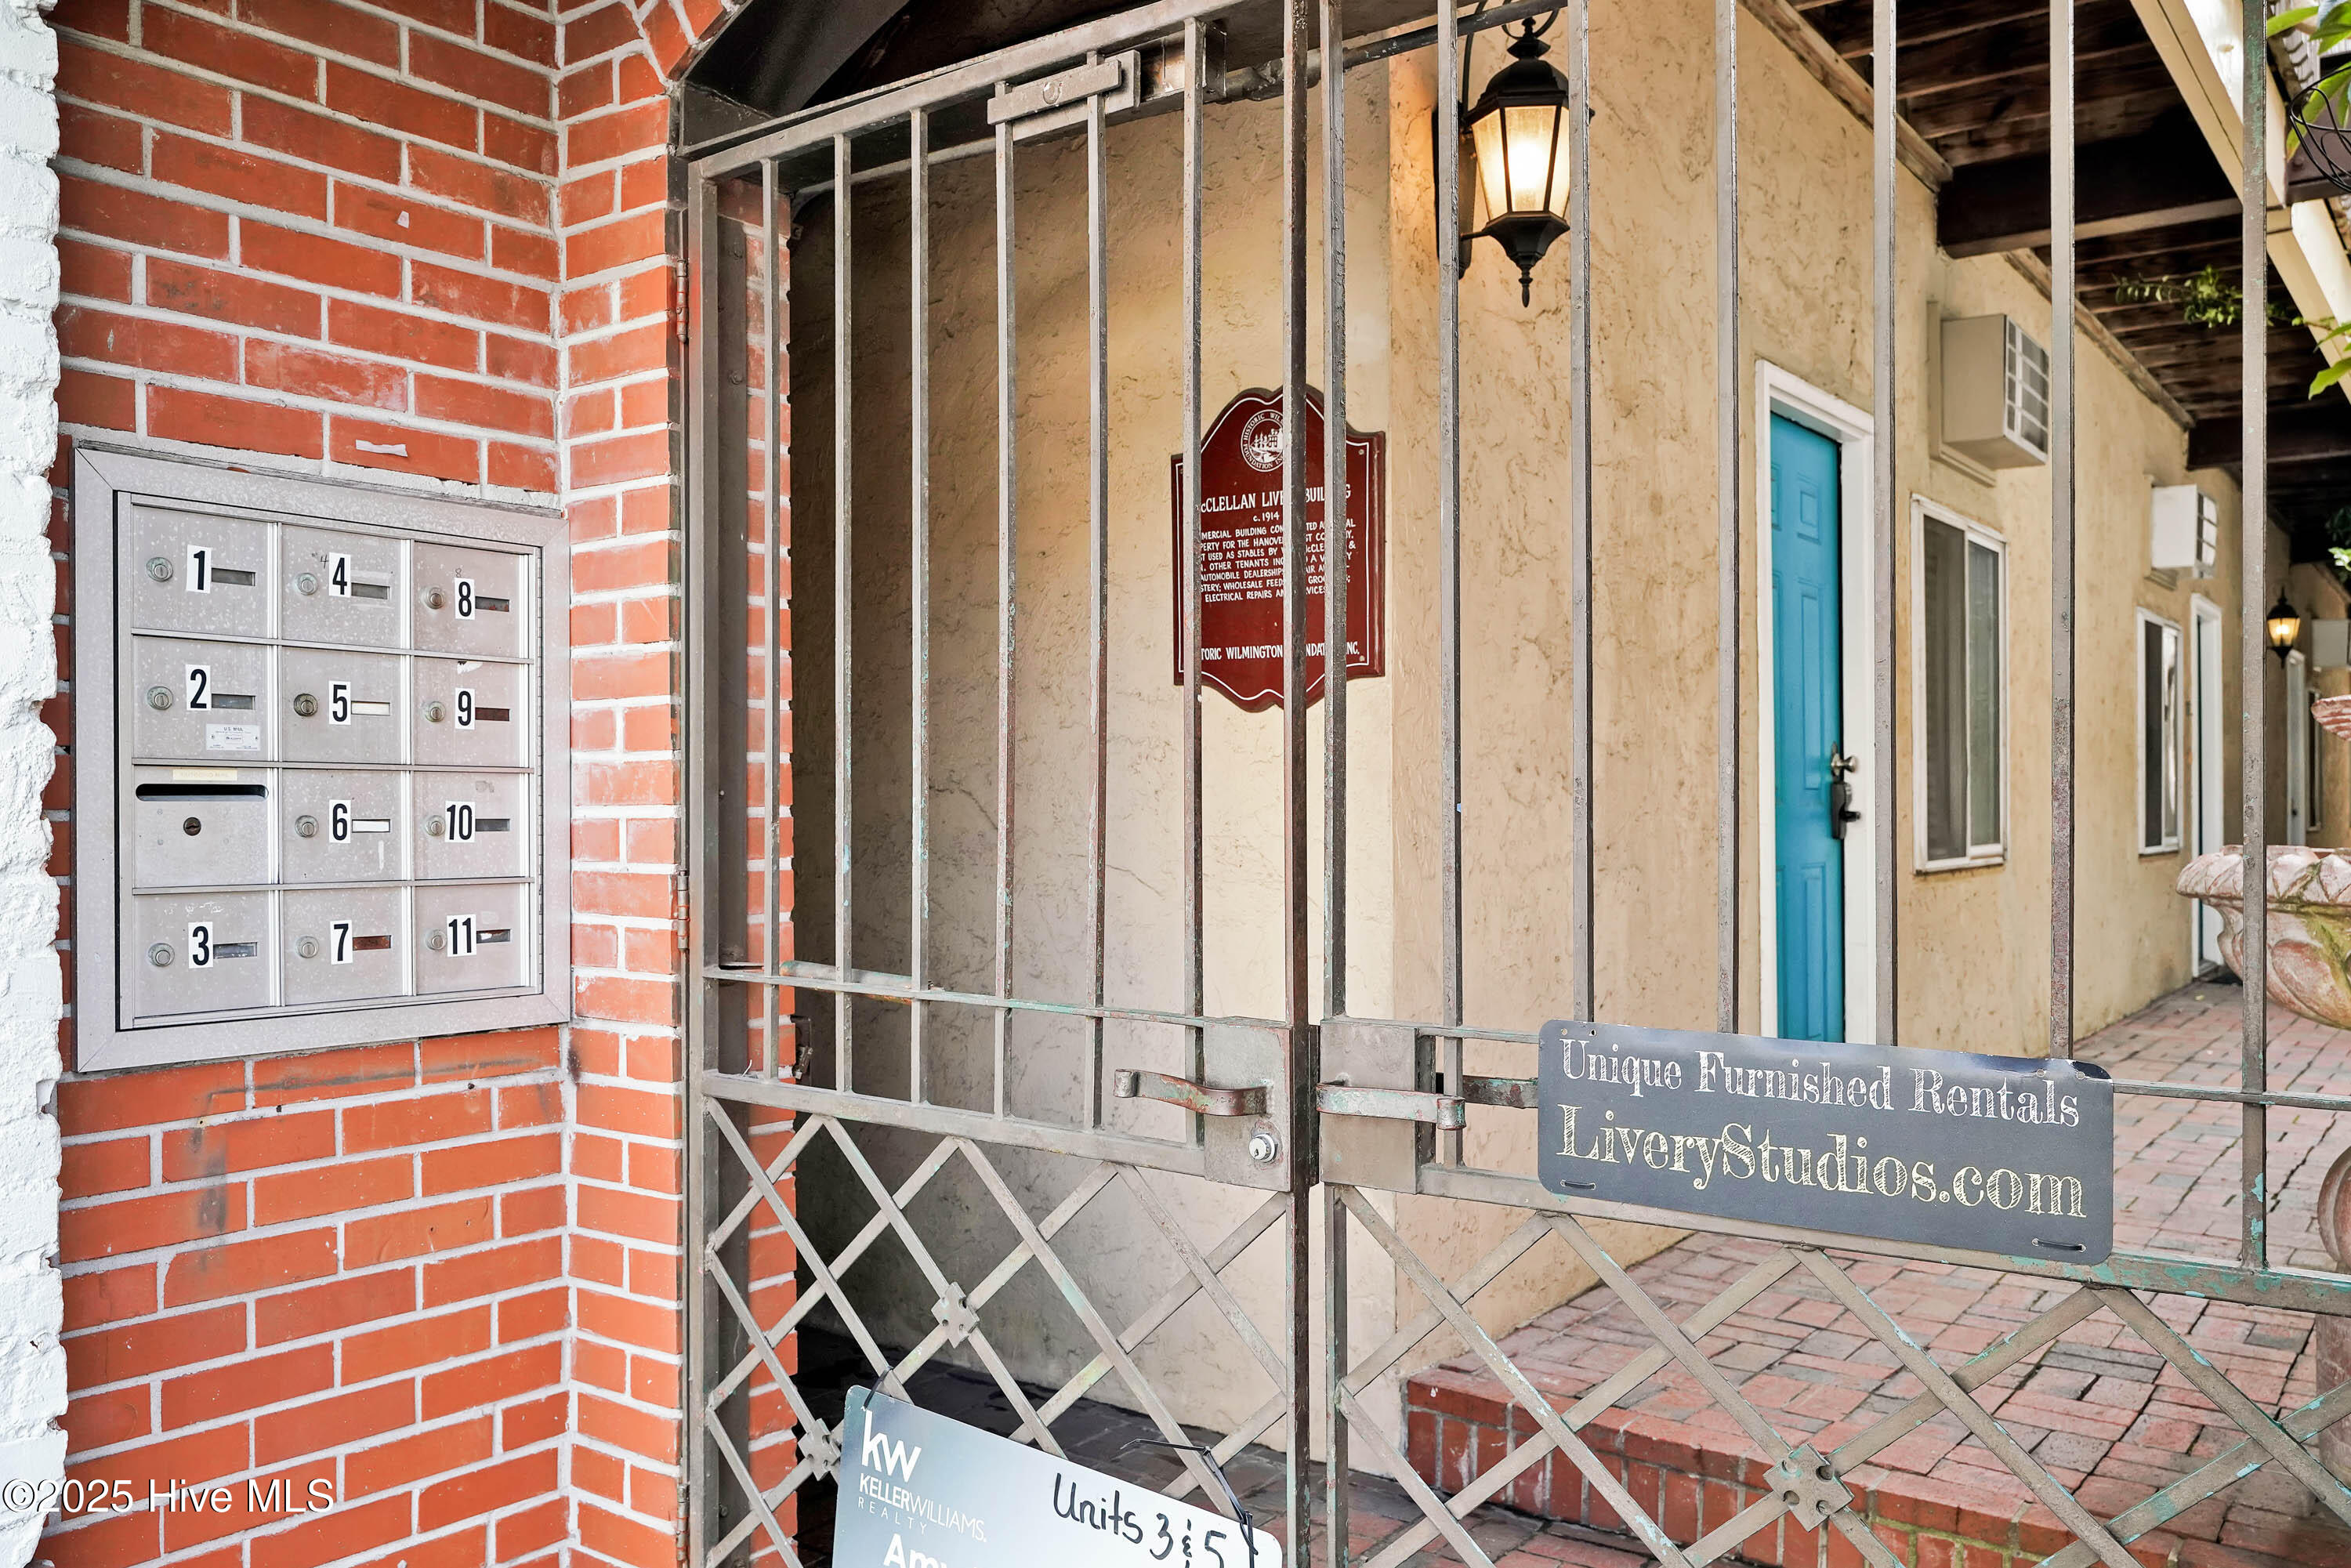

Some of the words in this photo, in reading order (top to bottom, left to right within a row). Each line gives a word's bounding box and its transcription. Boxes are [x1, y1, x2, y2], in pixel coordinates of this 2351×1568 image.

[1200, 492, 1256, 513] cCLELLAN
[1252, 514, 1261, 523] c.
[1262, 511, 1280, 523] 1914
[1201, 530, 1231, 541] MERCIAL
[1235, 527, 1267, 538] BUILDING
[1208, 552, 1223, 562] USED
[1226, 550, 1235, 559] AS
[1237, 549, 1265, 559] STABLES
[1268, 547, 1278, 556] BY
[1348, 540, 1357, 550] &
[1223, 540, 1236, 550] FOR
[1237, 538, 1250, 549] THE
[1253, 536, 1284, 547] HANOVE
[194, 550, 205, 590] 1
[332, 557, 348, 596] 4
[1201, 571, 1241, 582] AUTOMOBILE
[1209, 561, 1232, 571] OTHER
[1235, 558, 1270, 569] TENANTS
[1310, 554, 1317, 563] A
[458, 581, 472, 617] 8
[1204, 592, 1244, 603] ELECTRICAL
[1246, 589, 1273, 600] REPAIRS
[1223, 581, 1263, 592] WHOLESALE
[1266, 578, 1284, 588] FEED
[1201, 647, 1223, 661] TORIC
[1225, 644, 1284, 661] WILMINGTON
[190, 668, 207, 709] 2
[332, 684, 348, 722] 5
[458, 690, 472, 726] 9
[332, 803, 348, 841] 6
[447, 804, 473, 841] 10
[192, 925, 210, 966] 3
[333, 923, 349, 961] 7
[448, 918, 473, 954] 11
[1559, 1038, 1683, 1097] Unique
[1694, 1048, 1895, 1112] Furnished
[1907, 1067, 2080, 1128] Rentals
[1556, 1103, 2088, 1219] LiveryStudios.com
[858, 1496, 928, 1535] REALTY
[1053, 1472, 1143, 1544] Units
[1150, 1512, 1174, 1561] 3
[1204, 1530, 1227, 1568] 5
